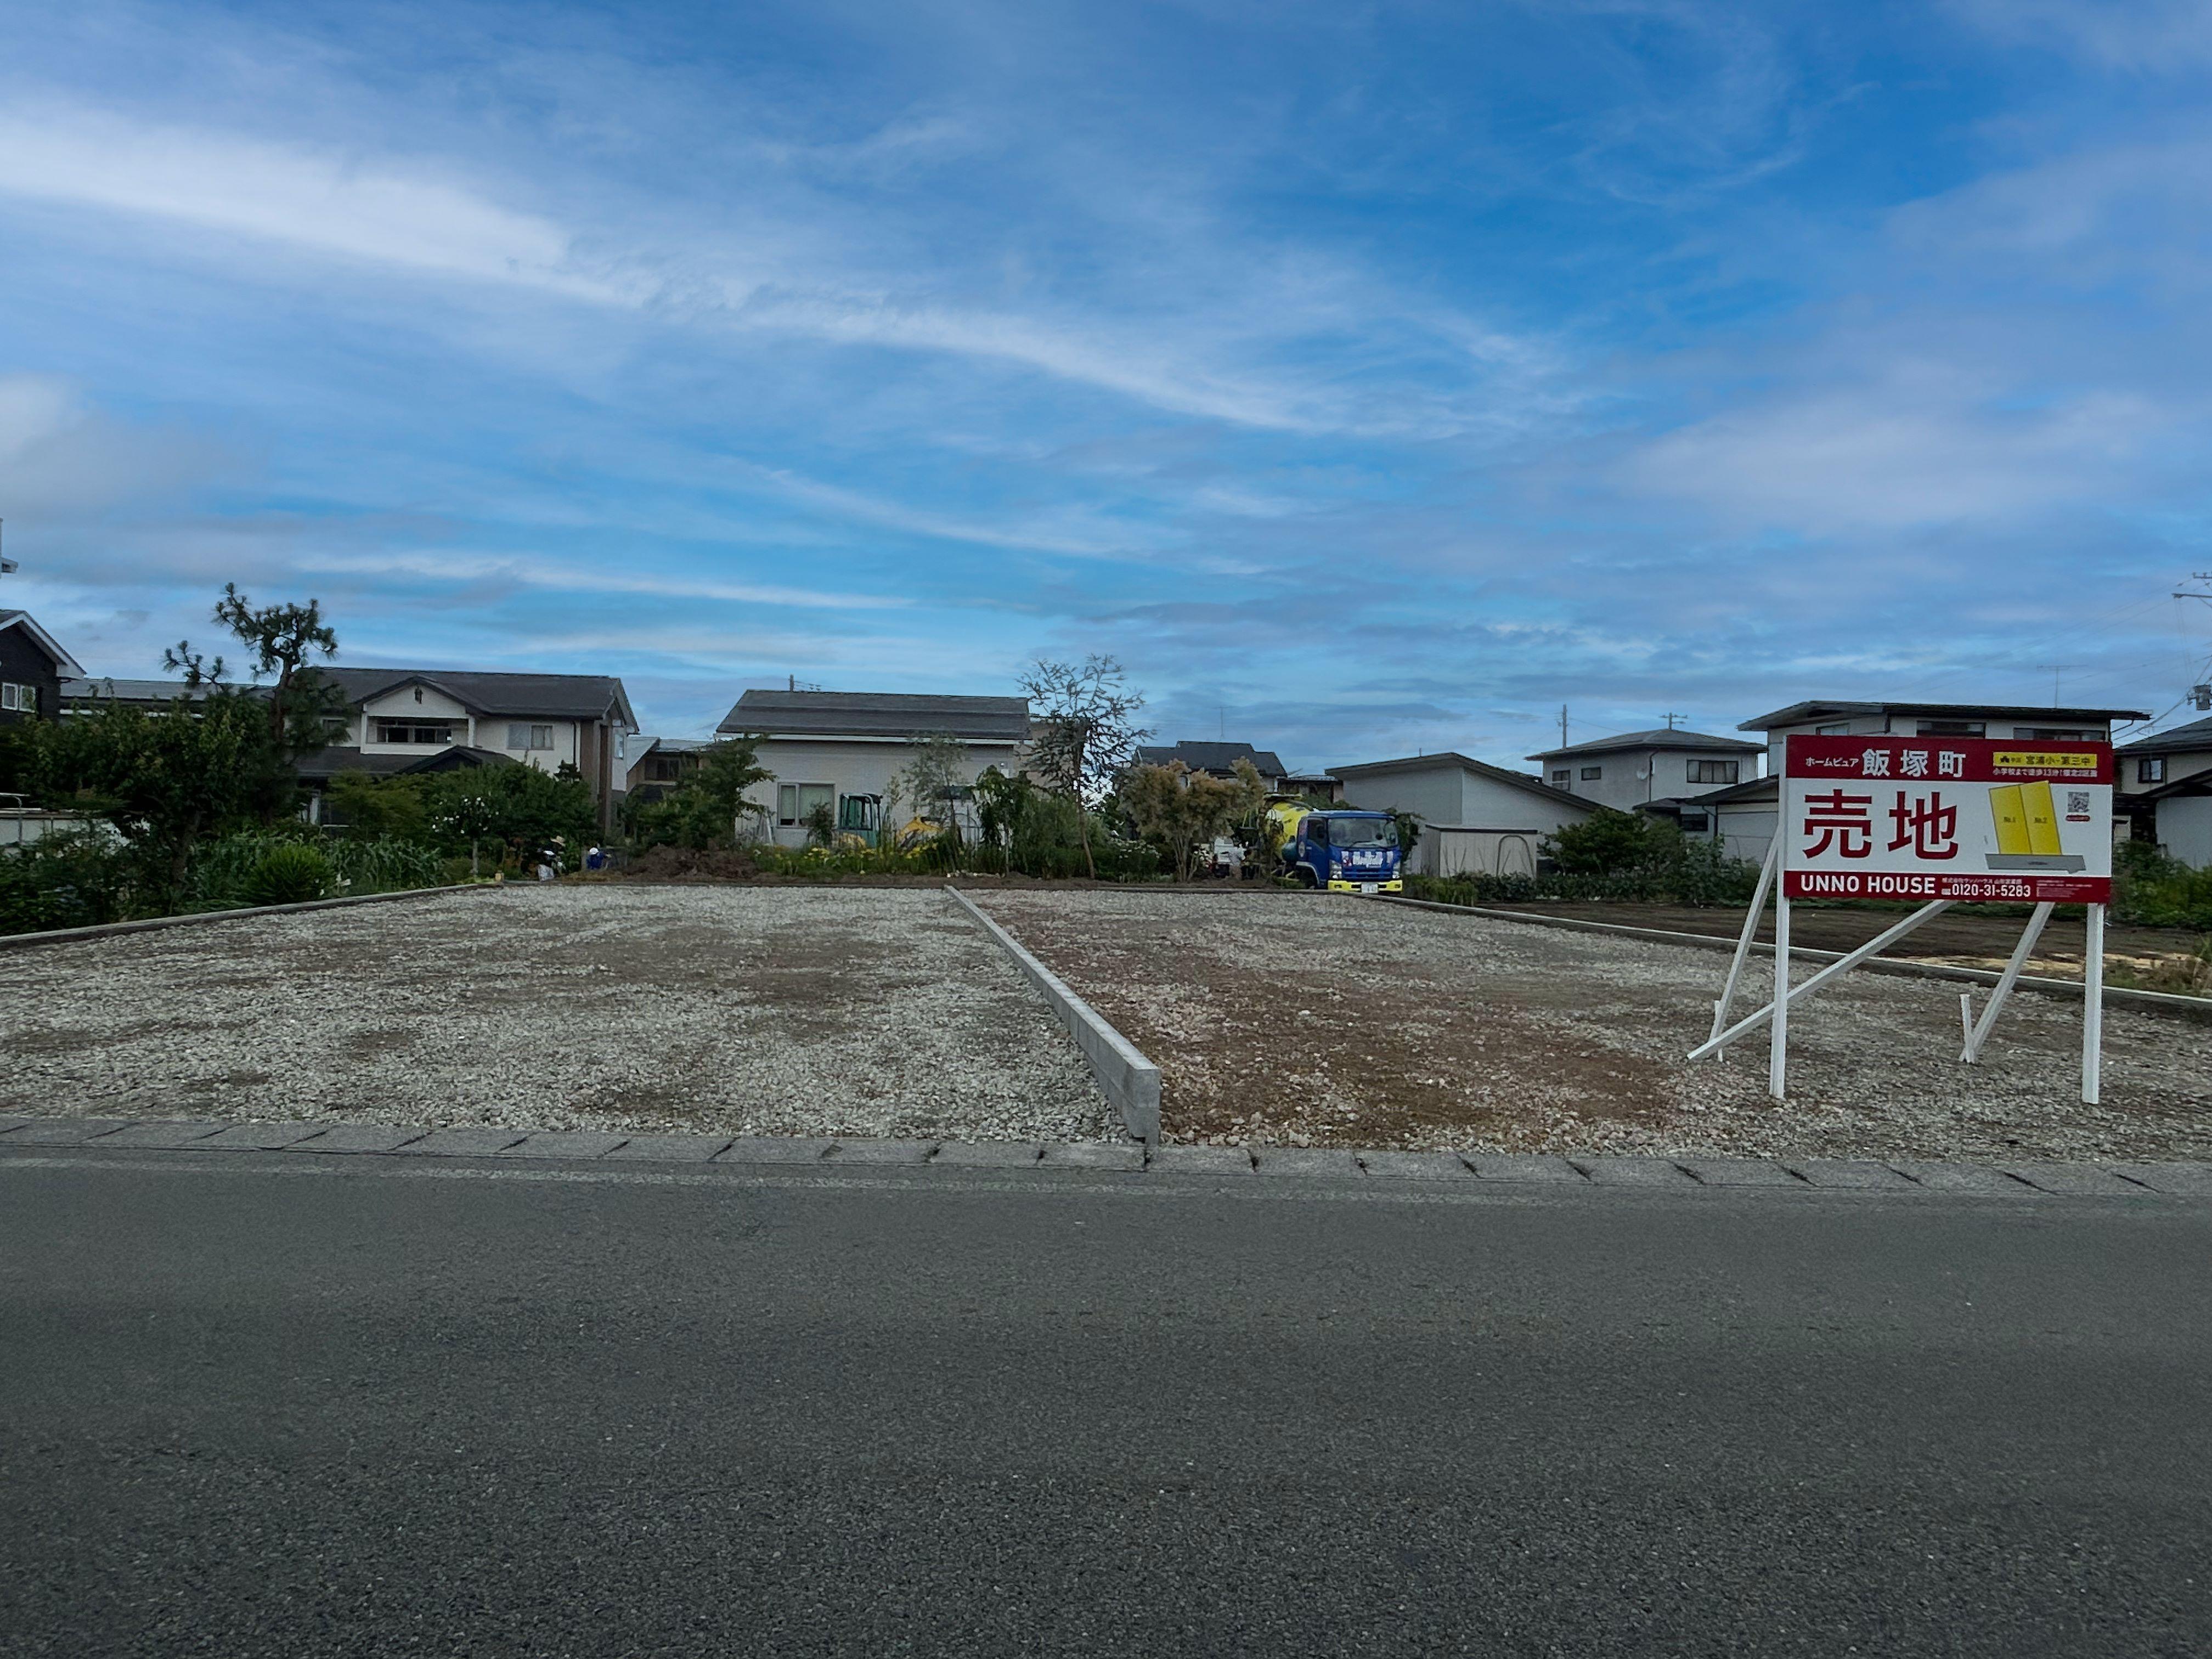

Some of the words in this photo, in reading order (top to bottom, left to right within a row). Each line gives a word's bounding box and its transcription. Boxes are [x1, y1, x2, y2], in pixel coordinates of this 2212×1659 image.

[1862, 748, 1966, 777] 飯塚町
[1802, 789, 1959, 860] 売地
[1801, 874, 1860, 891] UNNO
[1867, 876, 1936, 894] HOUSE
[1952, 883, 2031, 898] 0120-31-5283
